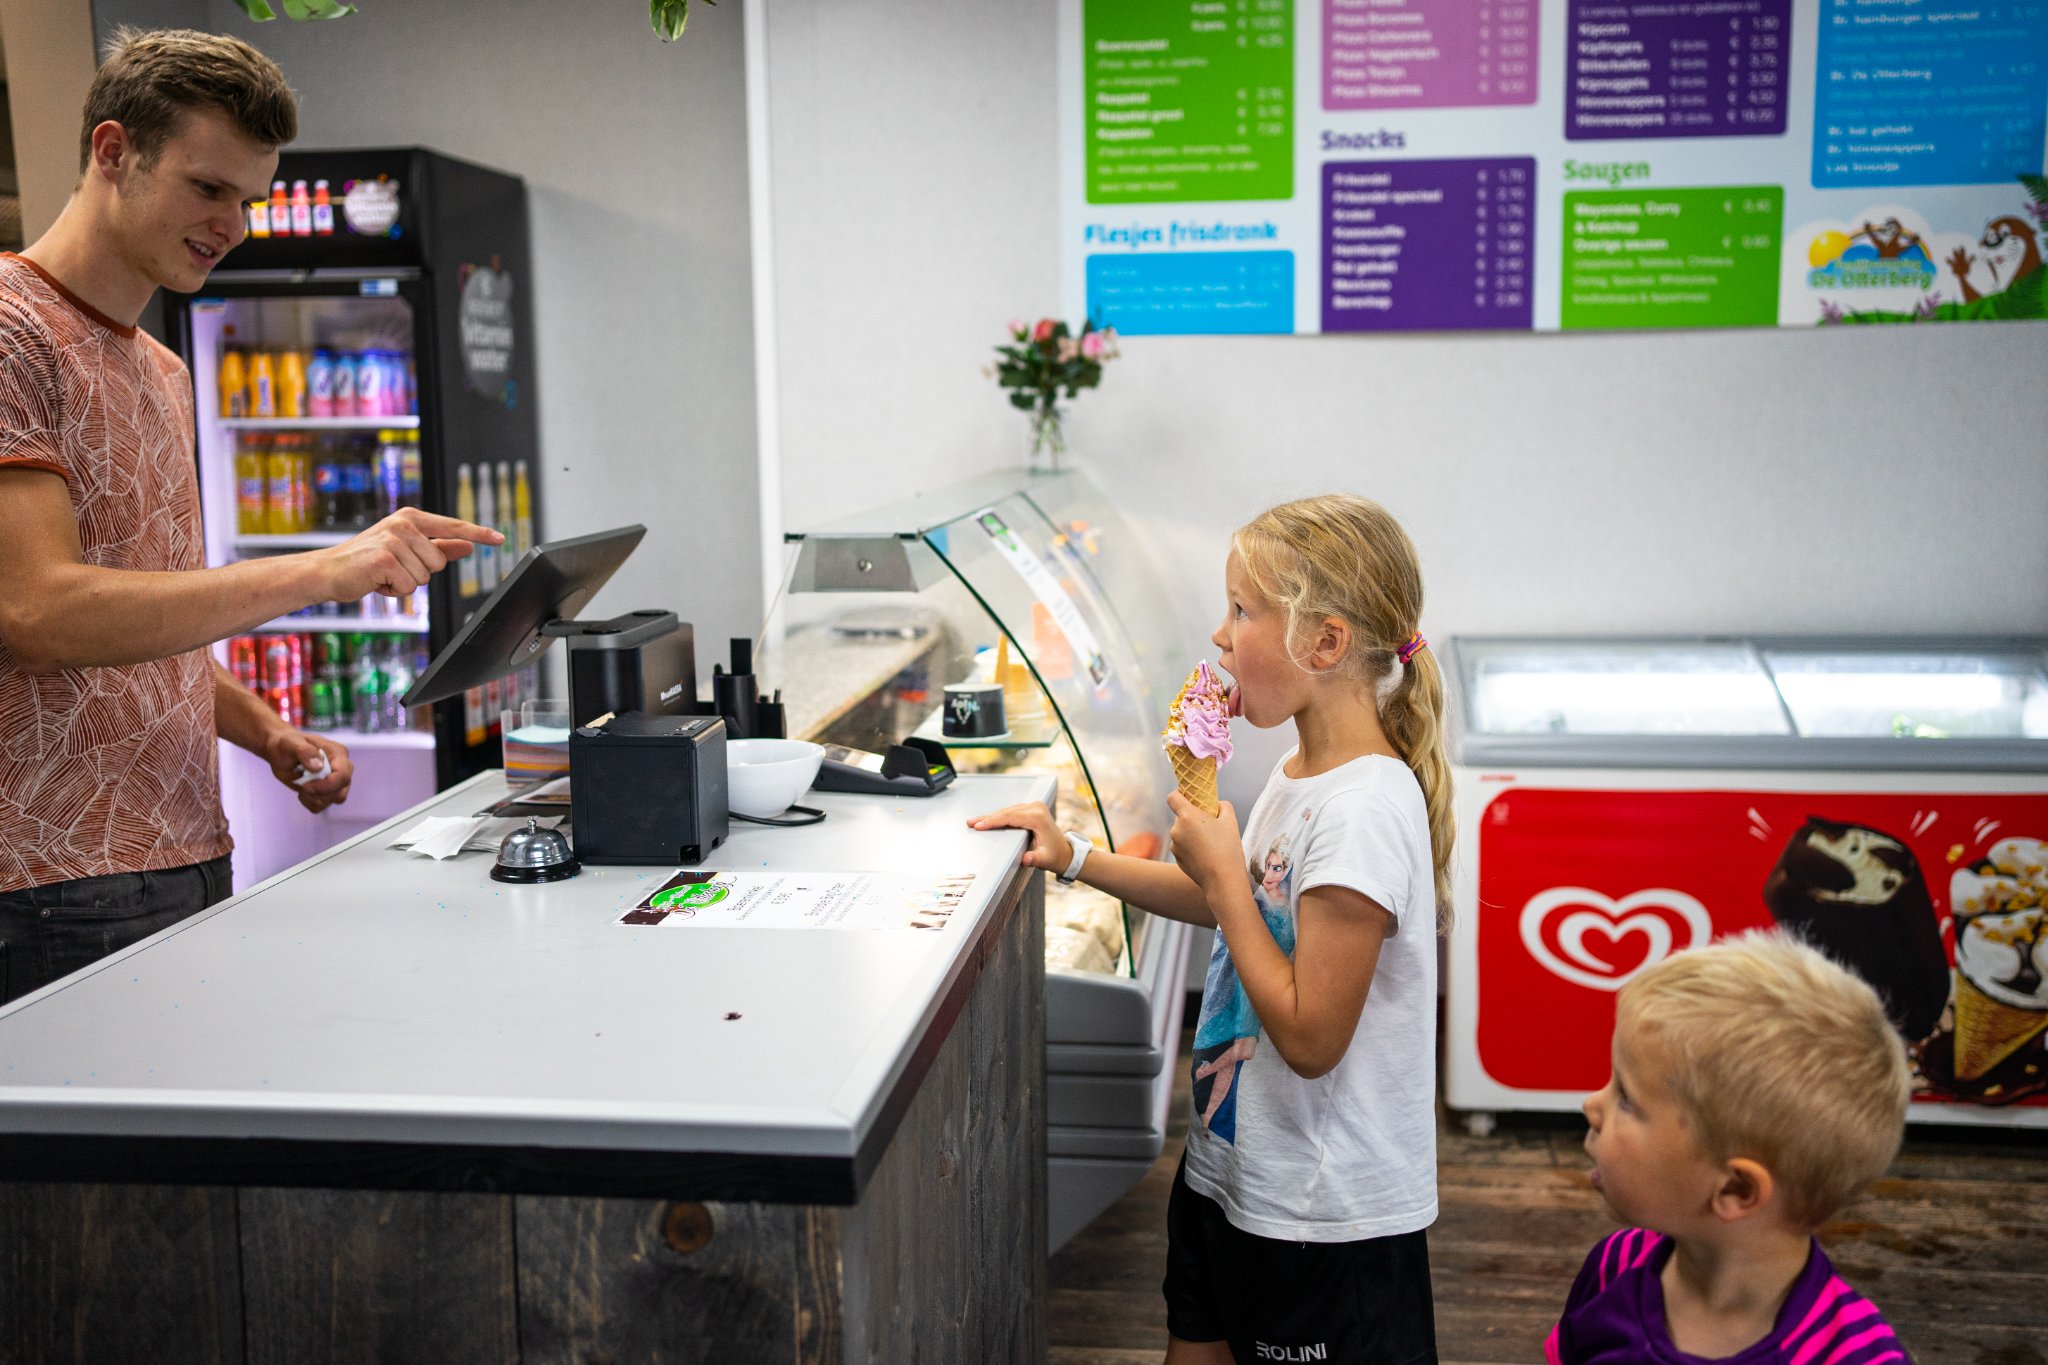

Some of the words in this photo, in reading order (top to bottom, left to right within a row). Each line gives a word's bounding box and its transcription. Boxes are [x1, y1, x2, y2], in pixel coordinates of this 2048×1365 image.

[1579, 23, 1629, 37] Kipcorn
[1334, 33, 1365, 44] Pizza
[1368, 31, 1431, 43] Carbonara
[1334, 51, 1365, 62] Pizza
[1368, 48, 1439, 63] Vegetarisch
[1578, 41, 1643, 56] Kipfingers
[1578, 59, 1650, 72] Bitterballen
[1334, 69, 1365, 80] Pizza
[1368, 67, 1405, 80] Tonijn
[1334, 86, 1365, 98] Pizza
[1368, 85, 1422, 97] Shoarma
[1578, 77, 1649, 92] Kipnuggets
[1321, 129, 1405, 150] Snacks
[1334, 174, 1390, 186] Frikandel
[1334, 192, 1389, 203] Frikandel
[1392, 190, 1441, 204] speciaal
[1334, 210, 1374, 221] Kroket
[1646, 202, 1681, 216] Curry
[1085, 223, 1163, 248] Flesjes
[1170, 220, 1278, 246] frisdrank
[1574, 221, 1585, 234] &
[1587, 221, 1640, 236] Ketchup
[1334, 245, 1400, 256] Hamburger
[1574, 239, 1622, 254] Overige
[1624, 239, 1668, 251] sauzen
[1356, 262, 1397, 275] gehakt
[1334, 280, 1391, 290] Mexicano
[1810, 271, 1836, 288] De
[1841, 270, 1934, 292] Otterberg
[1256, 1340, 1327, 1362] ROLINI
